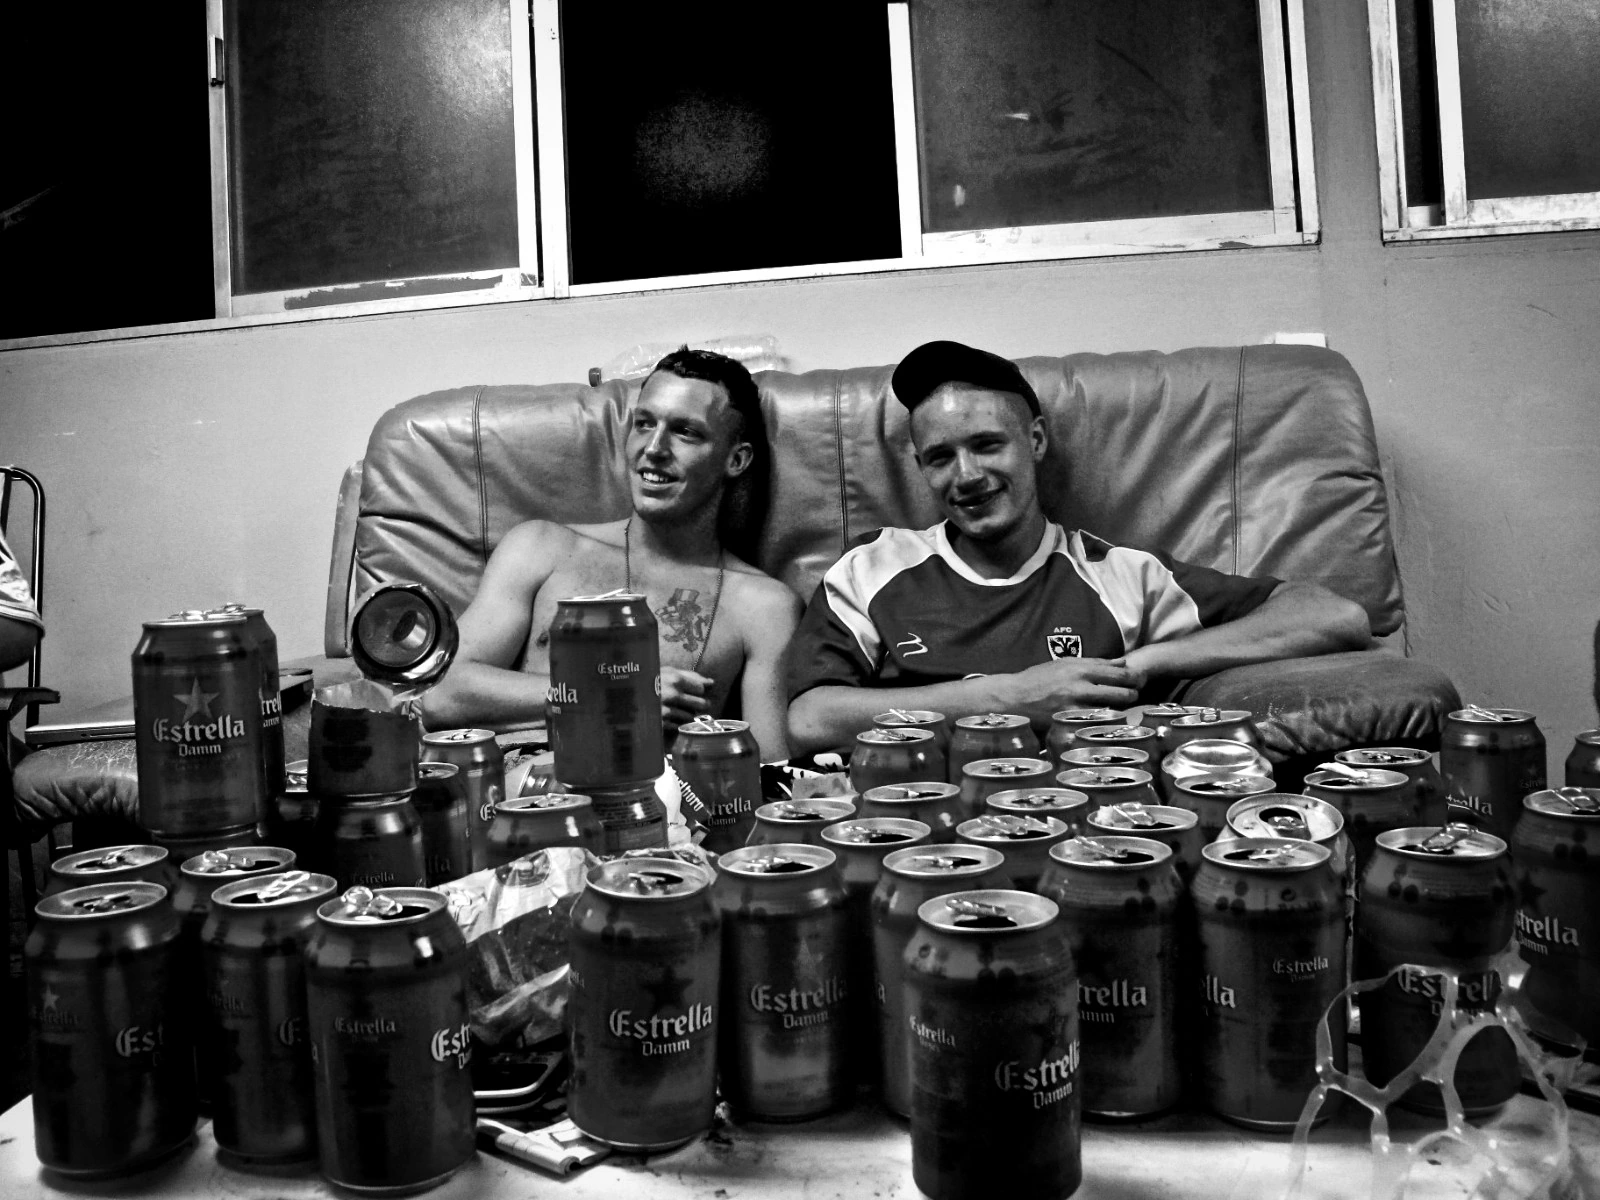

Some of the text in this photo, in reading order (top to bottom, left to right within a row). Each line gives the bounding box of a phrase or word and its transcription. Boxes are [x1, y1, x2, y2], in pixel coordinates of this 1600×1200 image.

[597, 662, 640, 675] Estrella
[152, 715, 246, 743] Estrella
[178, 743, 222, 758] Damm
[1515, 908, 1580, 947] strella
[1272, 956, 1329, 975] Estrella
[1077, 978, 1148, 1007] trella
[334, 1016, 396, 1035] Estrella
[609, 1002, 713, 1040] Estrella
[782, 1010, 829, 1030] Damm
[641, 1039, 691, 1057] Damm
[1032, 1081, 1073, 1111] Damm
